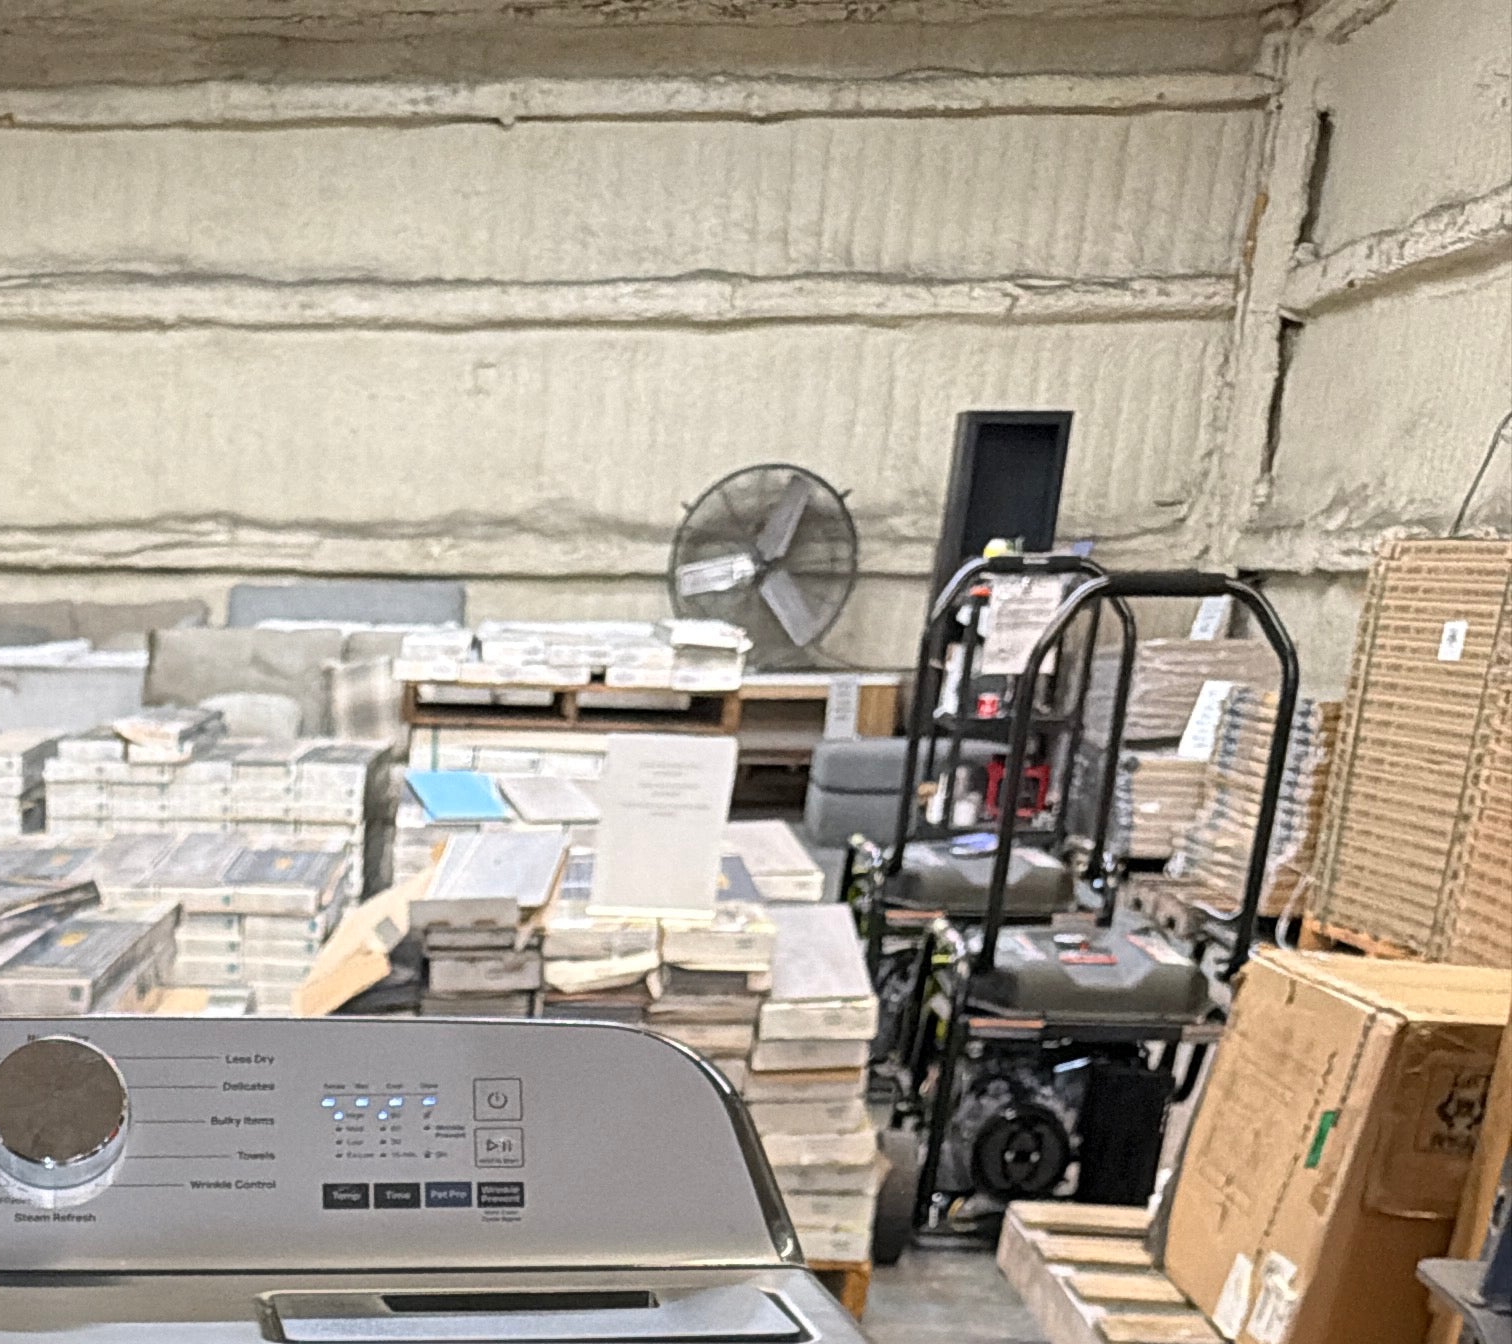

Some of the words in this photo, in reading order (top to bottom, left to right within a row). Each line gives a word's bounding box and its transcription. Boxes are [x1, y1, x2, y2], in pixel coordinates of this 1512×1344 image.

[225, 1054, 252, 1065] Less
[254, 1053, 275, 1065] Dry
[222, 1081, 275, 1091] Delicates
[210, 1115, 241, 1128] Bulky
[236, 1150, 276, 1160] Towels
[189, 1180, 232, 1189] Wrinkle
[234, 1180, 276, 1189] Control
[386, 1190, 411, 1200] Time
[449, 1189, 467, 1199] Pro
[14, 1212, 50, 1223] Steam
[52, 1212, 96, 1223] Refresh
